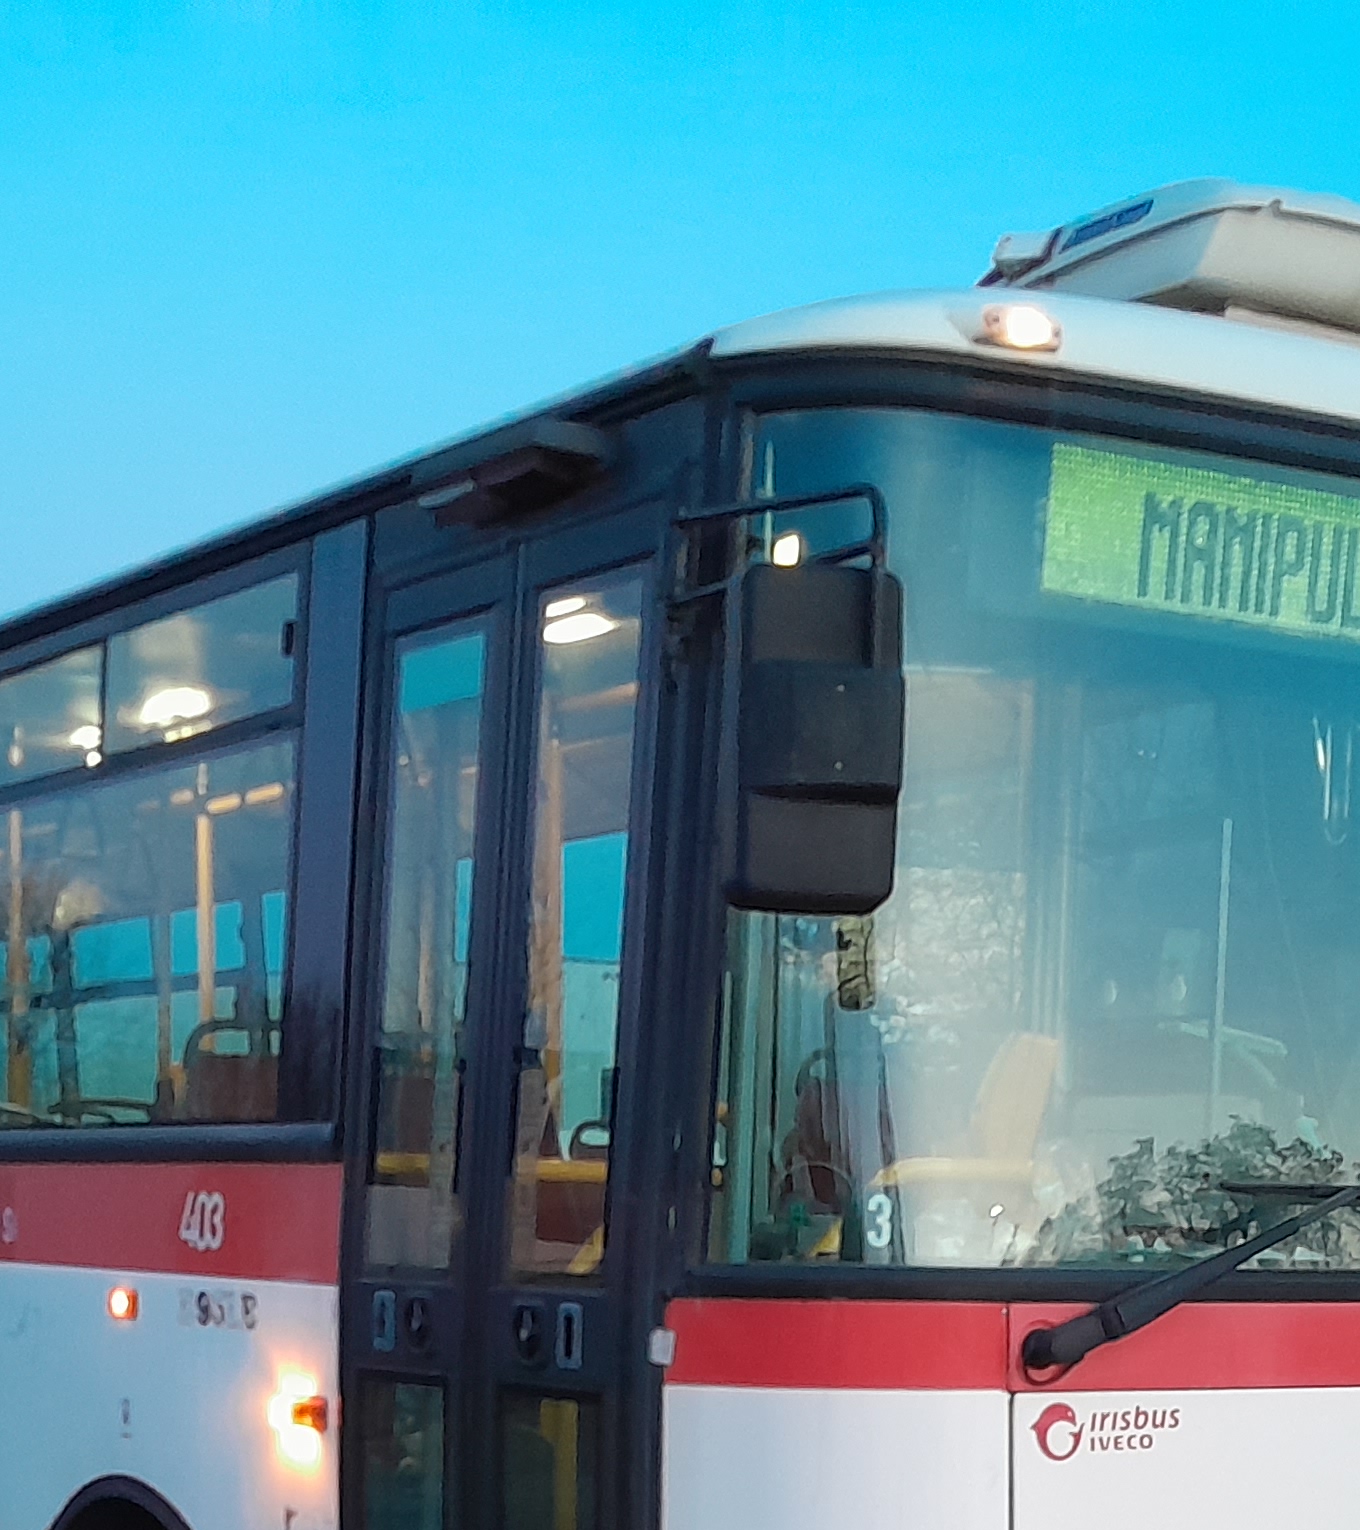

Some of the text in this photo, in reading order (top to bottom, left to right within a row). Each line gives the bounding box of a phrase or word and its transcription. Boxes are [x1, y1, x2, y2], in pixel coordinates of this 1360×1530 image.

[867, 1193, 893, 1249] 3
[1090, 1404, 1181, 1433] irisbus
[1090, 1433, 1154, 1452] IVECO
